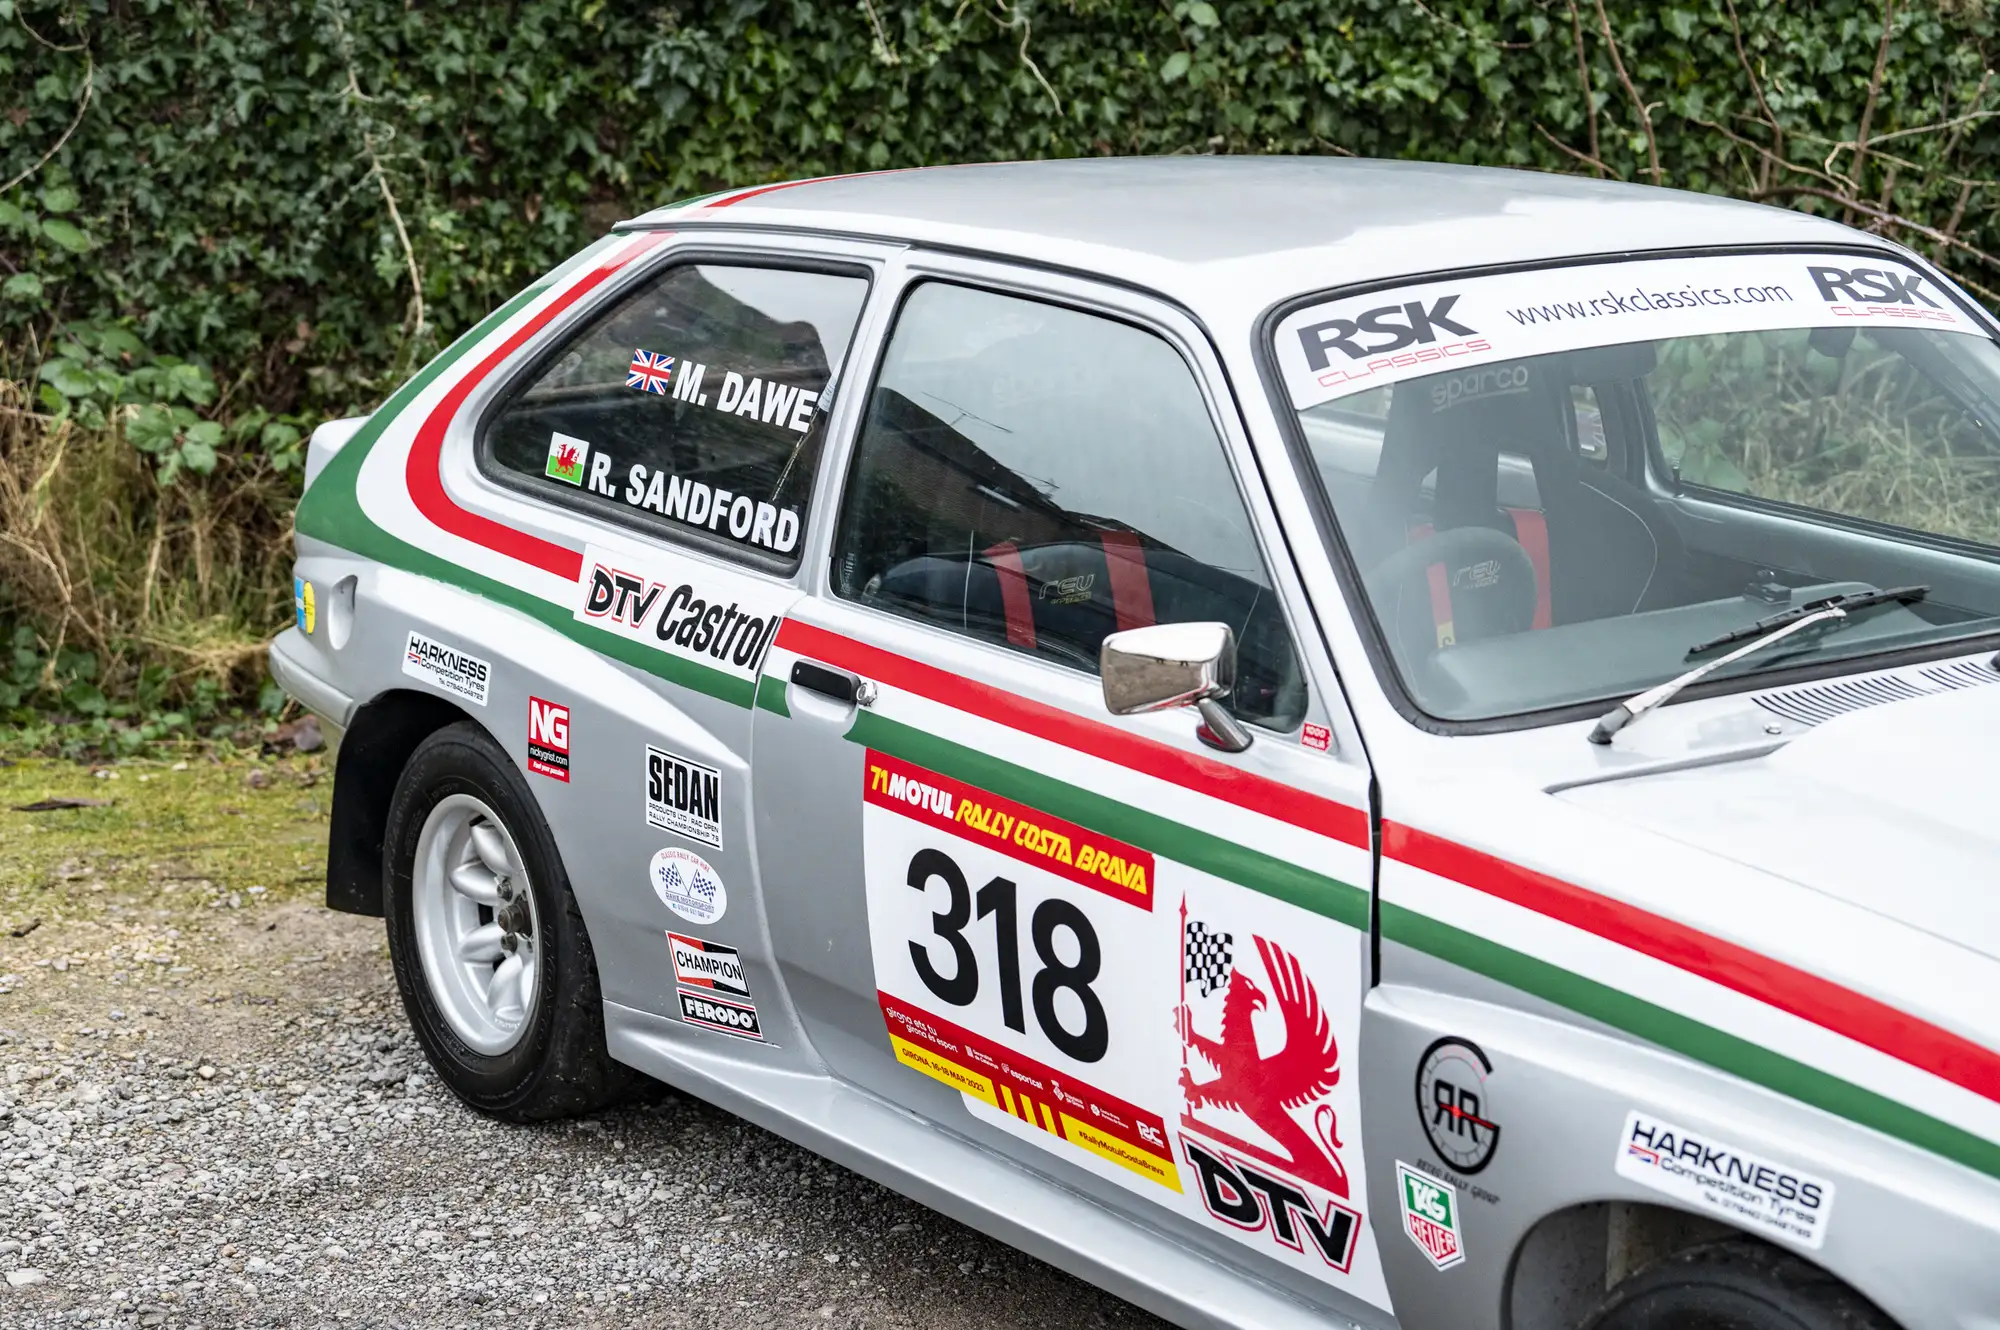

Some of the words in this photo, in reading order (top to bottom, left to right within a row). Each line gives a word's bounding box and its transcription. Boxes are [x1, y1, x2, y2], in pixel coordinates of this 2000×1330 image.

[1507, 284, 1793, 327] www.rskclassics.com
[1806, 266, 1943, 309] RSK
[1297, 294, 1479, 373] RSK
[1830, 305, 1956, 323] CLASSICS
[1318, 338, 1492, 388] CLASSICS
[1431, 364, 1529, 406] sparco
[672, 360, 706, 407] M.
[716, 370, 819, 433] DAWE
[588, 451, 615, 497] R.
[625, 464, 800, 552] SANDFORD
[584, 563, 666, 629] DTV
[656, 584, 779, 671] Castrol
[409, 636, 487, 682] HARKNESS
[421, 658, 464, 683] Competition
[465, 676, 485, 692] Tyres
[530, 700, 568, 749] NG
[530, 746, 568, 766] nickygrist.com
[649, 754, 719, 824] SEDAN
[649, 802, 676, 819] PRODUCTS
[677, 814, 687, 822] LTD
[704, 823, 719, 834] OPEN
[649, 811, 665, 822] RALLY
[667, 817, 710, 838] CHAMPIONSHIP
[870, 764, 889, 794] 71
[887, 772, 954, 820] MOTUL
[955, 799, 1015, 840] RALLY
[1013, 819, 1073, 865] COSTA
[1075, 844, 1148, 895] BRAVA
[676, 950, 743, 981] CHAMPION
[907, 848, 1109, 1063] 318
[684, 998, 753, 1029] FERODO
[886, 1007, 912, 1023] girona
[1632, 1120, 1823, 1210] HARKNESS
[1660, 1157, 1763, 1205] Competition
[1177, 1130, 1362, 1274] DTV
[1408, 1177, 1447, 1222] TAG
[1769, 1196, 1817, 1225] Tyres
[1409, 1214, 1457, 1259] HEUER
